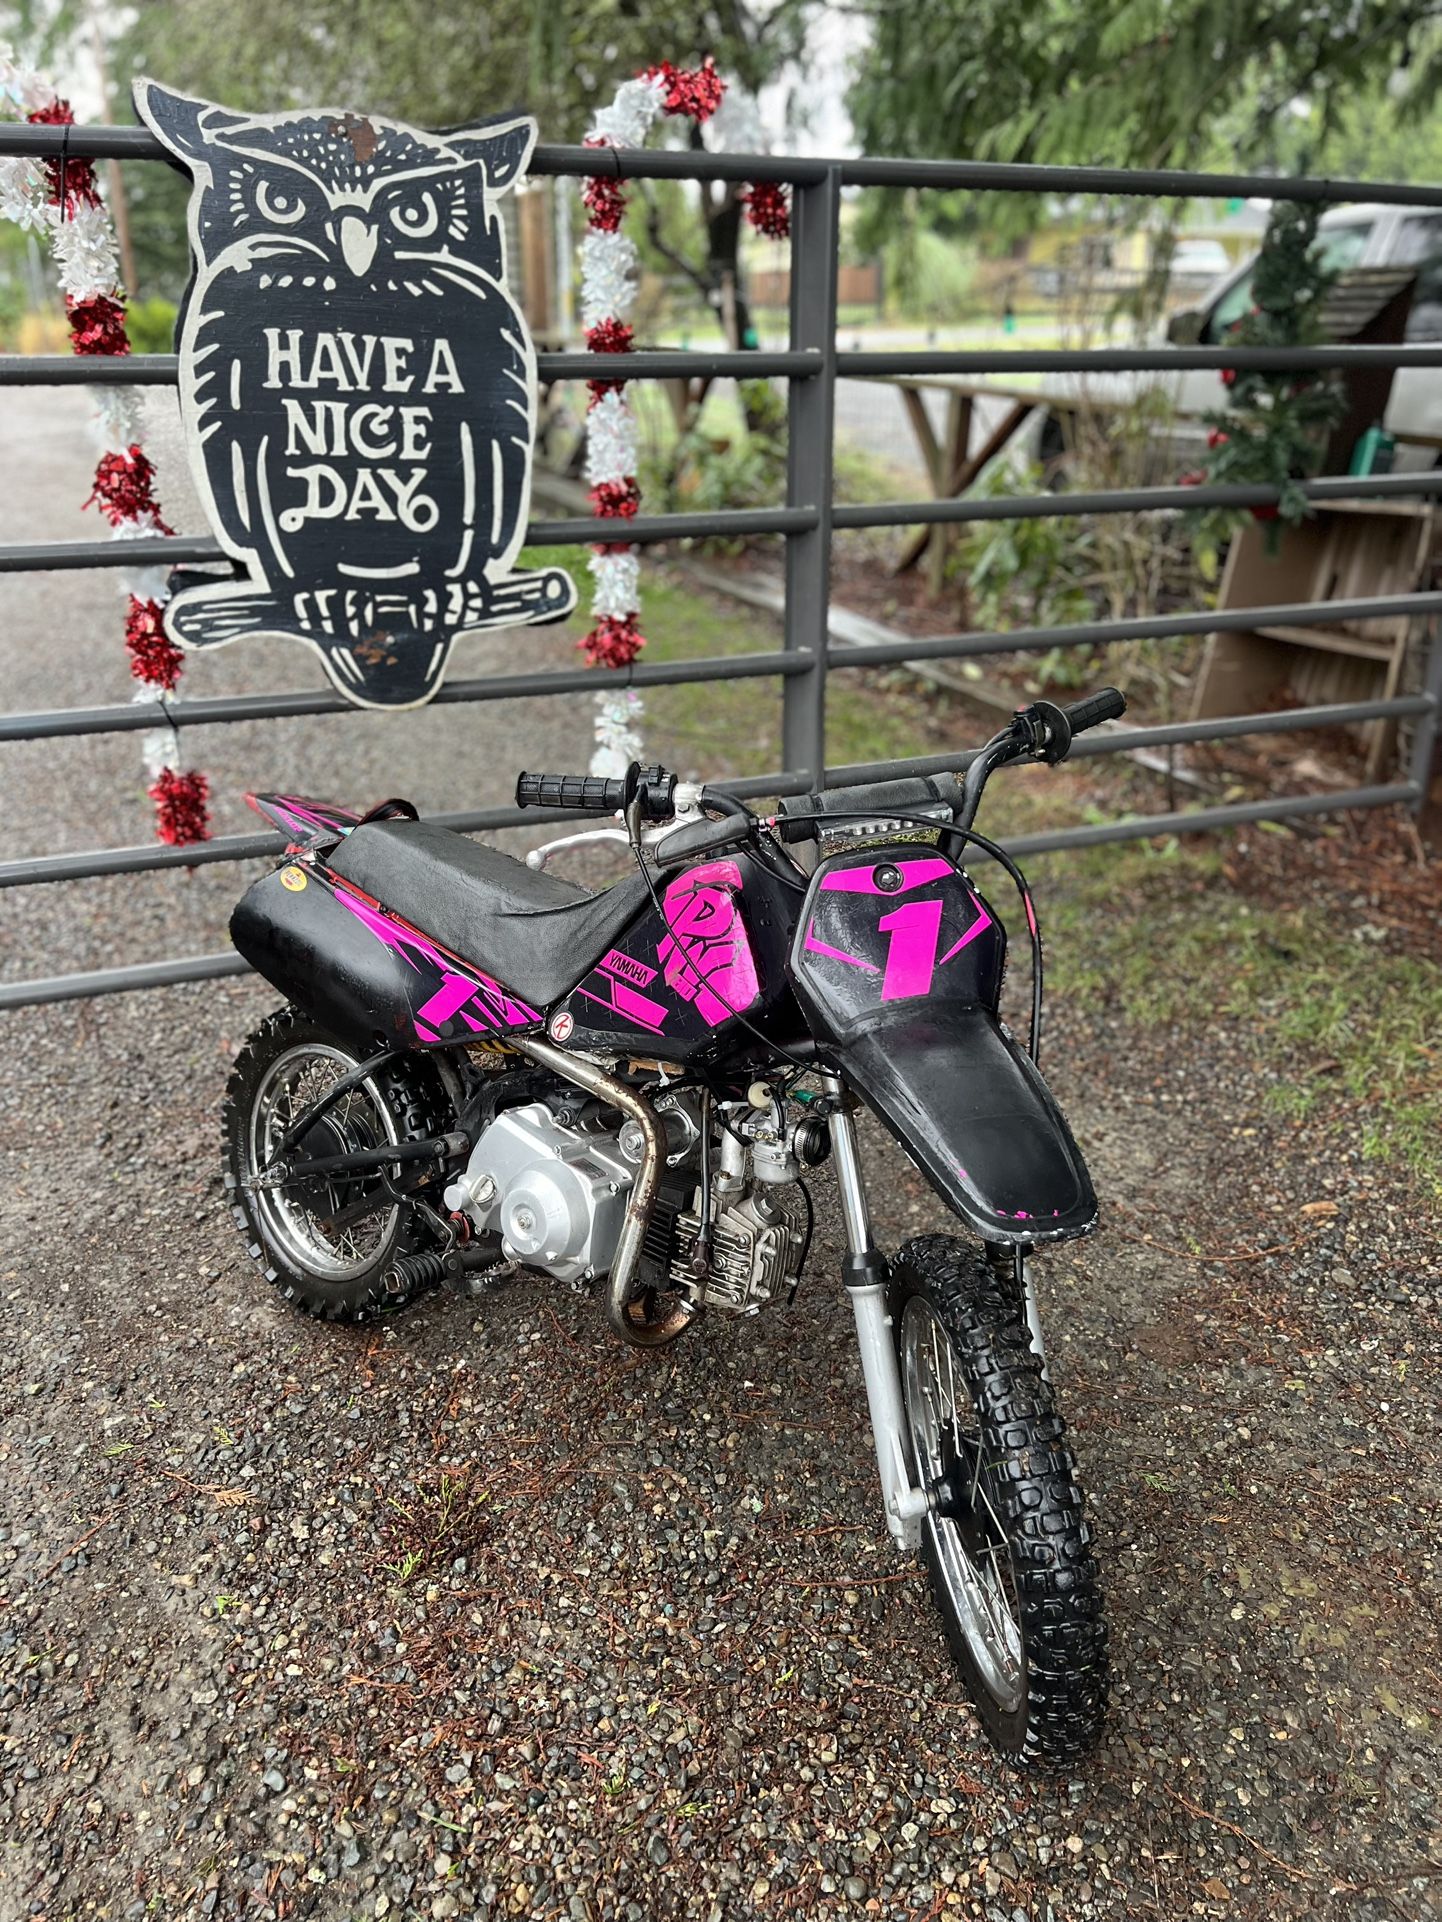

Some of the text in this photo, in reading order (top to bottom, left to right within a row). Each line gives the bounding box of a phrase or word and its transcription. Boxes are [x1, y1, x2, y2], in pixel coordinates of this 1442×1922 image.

[262, 328, 466, 393] HAVE A
[281, 398, 434, 460] NICE
[278, 463, 440, 533] DAY
[609, 953, 649, 984] YAMAHA
[878, 899, 943, 1001] 1
